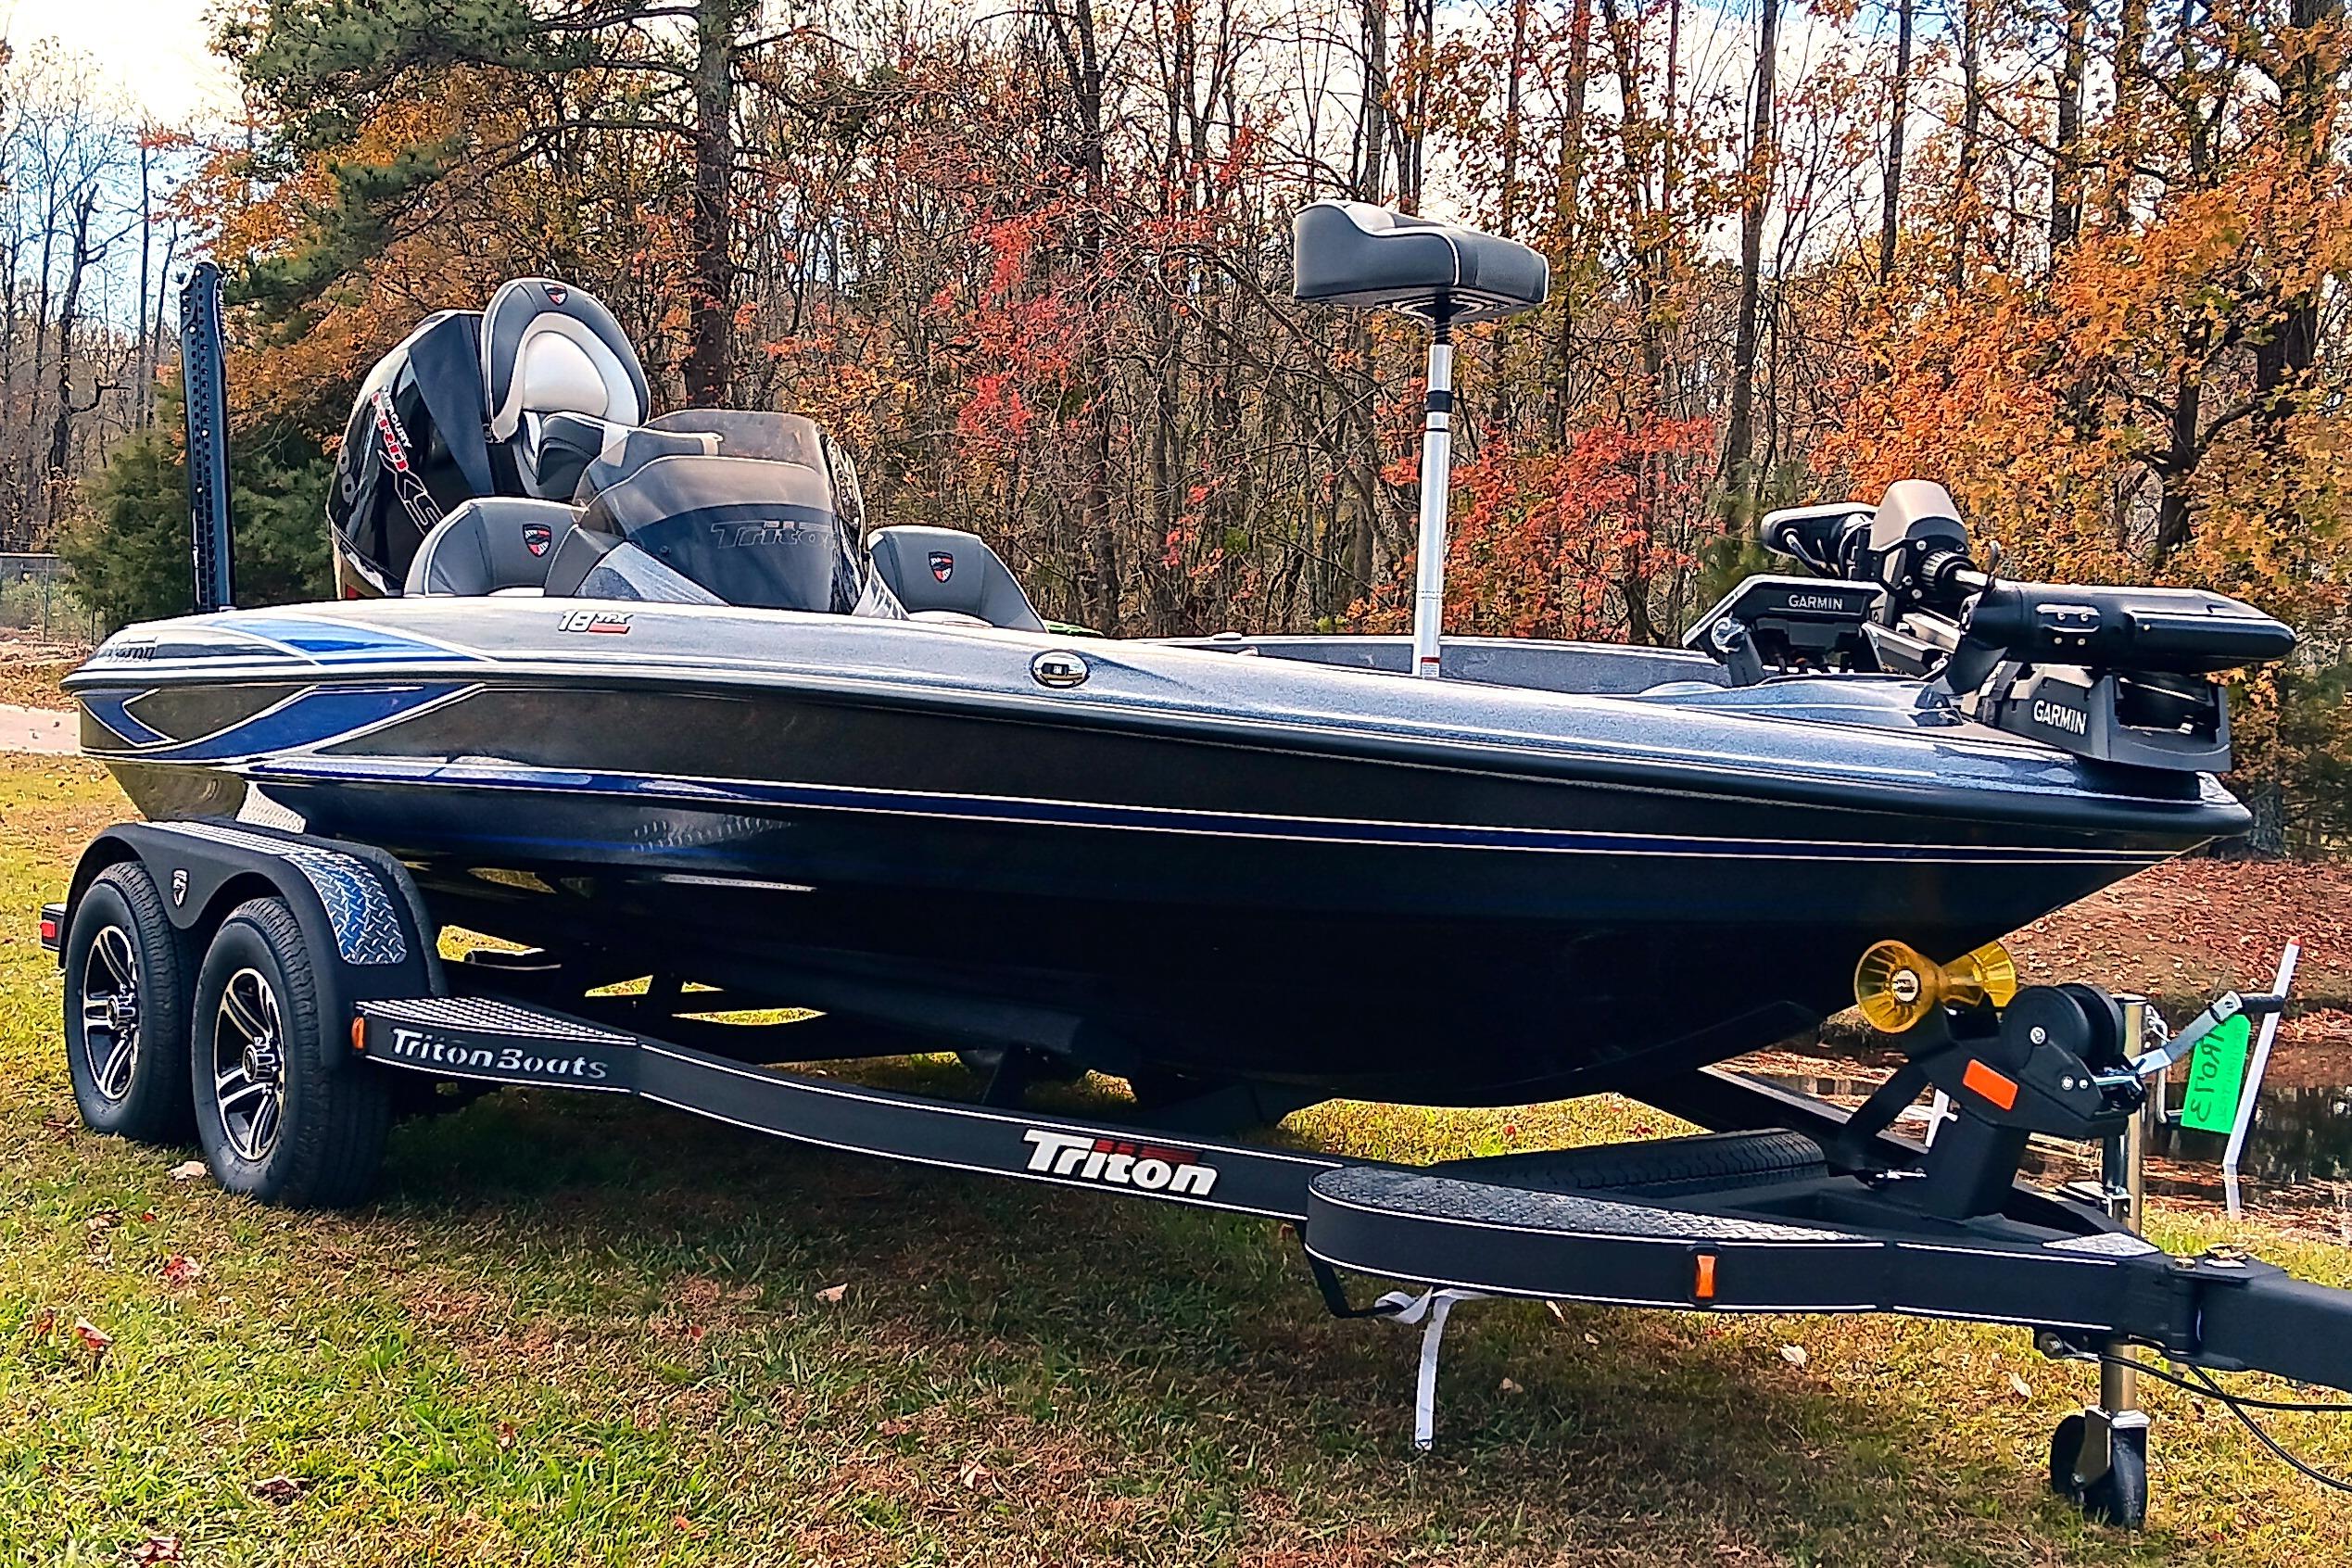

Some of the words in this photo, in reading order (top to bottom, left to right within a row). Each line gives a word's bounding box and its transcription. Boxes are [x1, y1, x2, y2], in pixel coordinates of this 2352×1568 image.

[1788, 594, 1843, 610] GARMIN
[558, 611, 596, 632] 18
[2033, 700, 2088, 735] GARMIN
[1023, 1128, 1219, 1196] Triton
